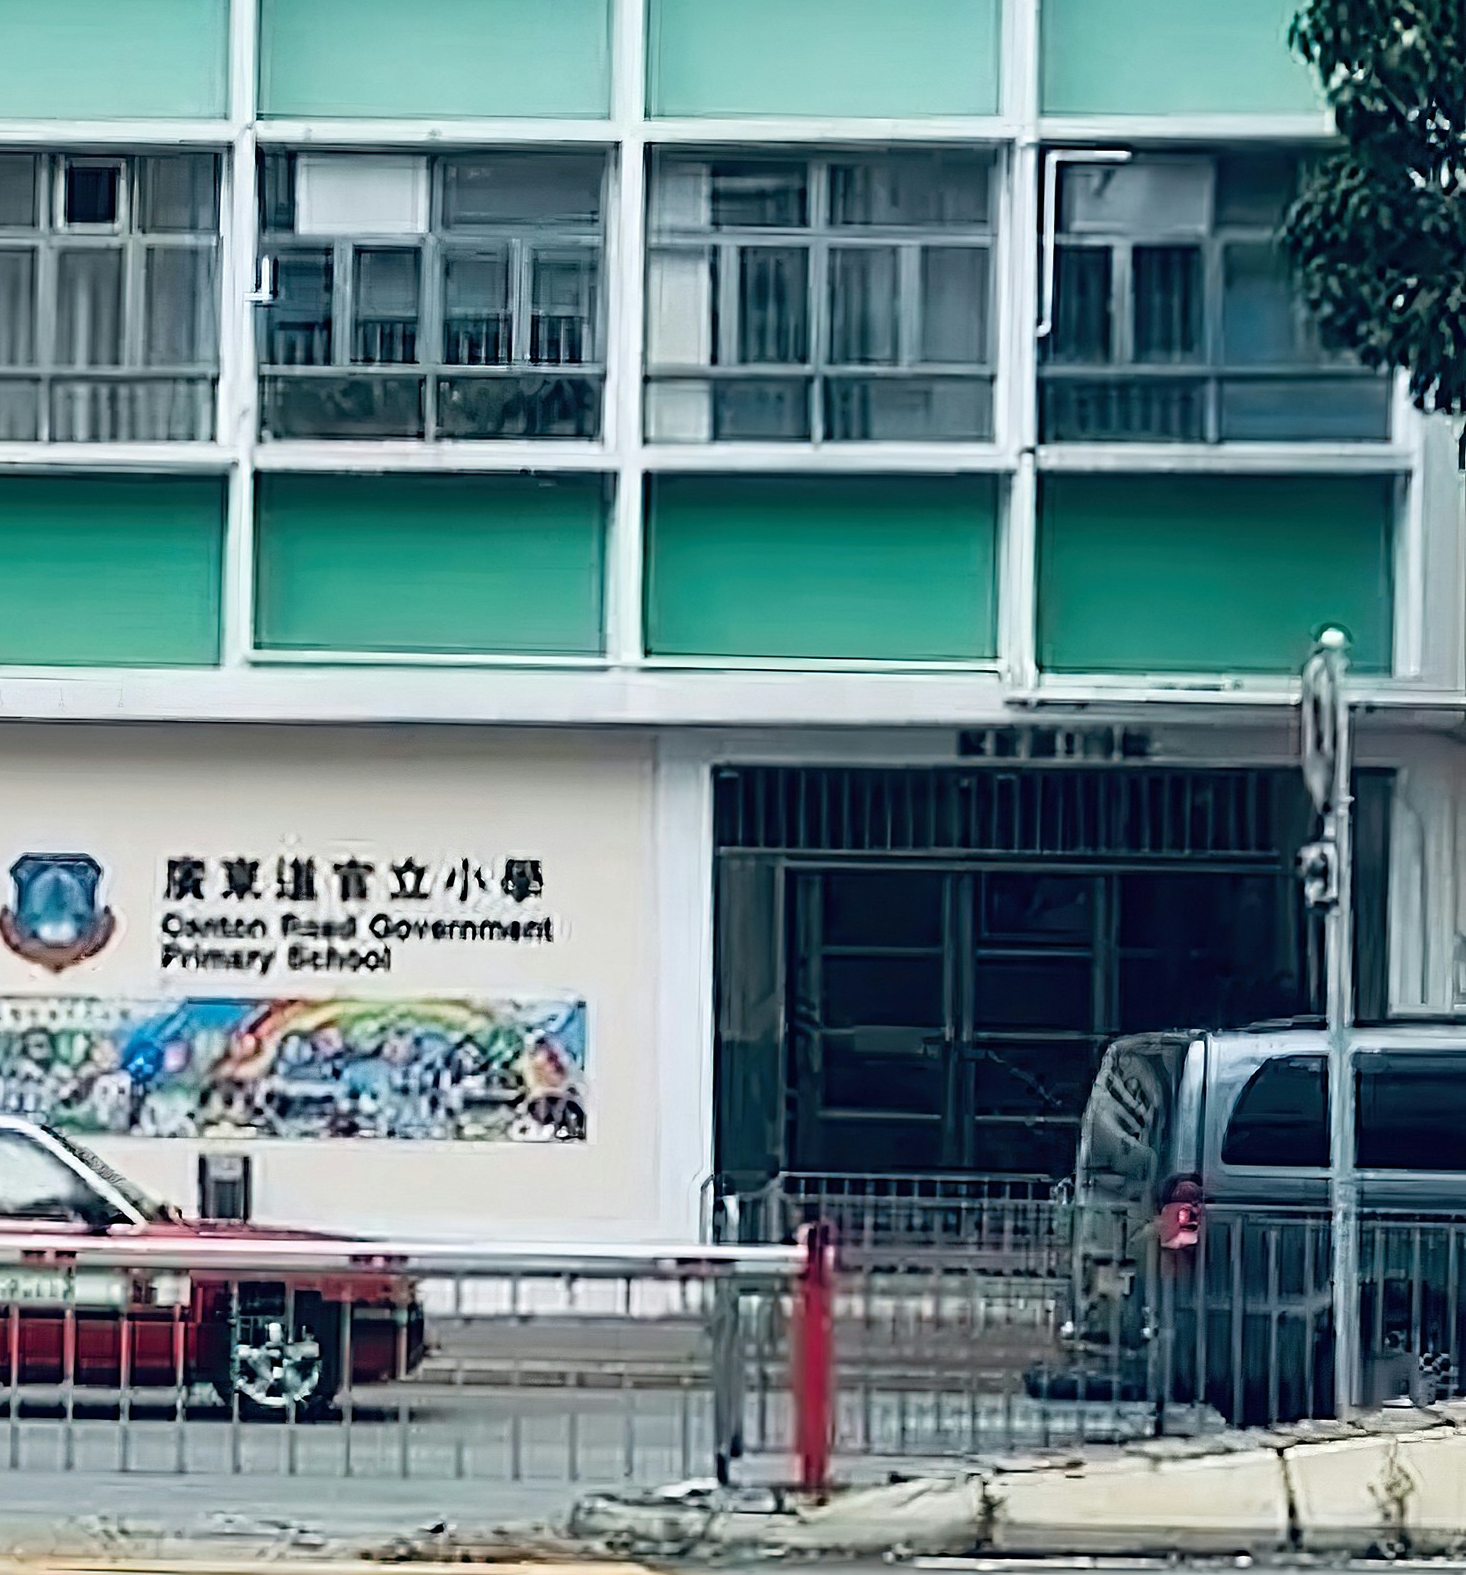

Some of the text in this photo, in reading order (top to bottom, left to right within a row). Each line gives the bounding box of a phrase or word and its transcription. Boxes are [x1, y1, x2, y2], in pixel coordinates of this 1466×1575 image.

[161, 913, 554, 943] Canton Road Government
[161, 944, 391, 975] Primary School
